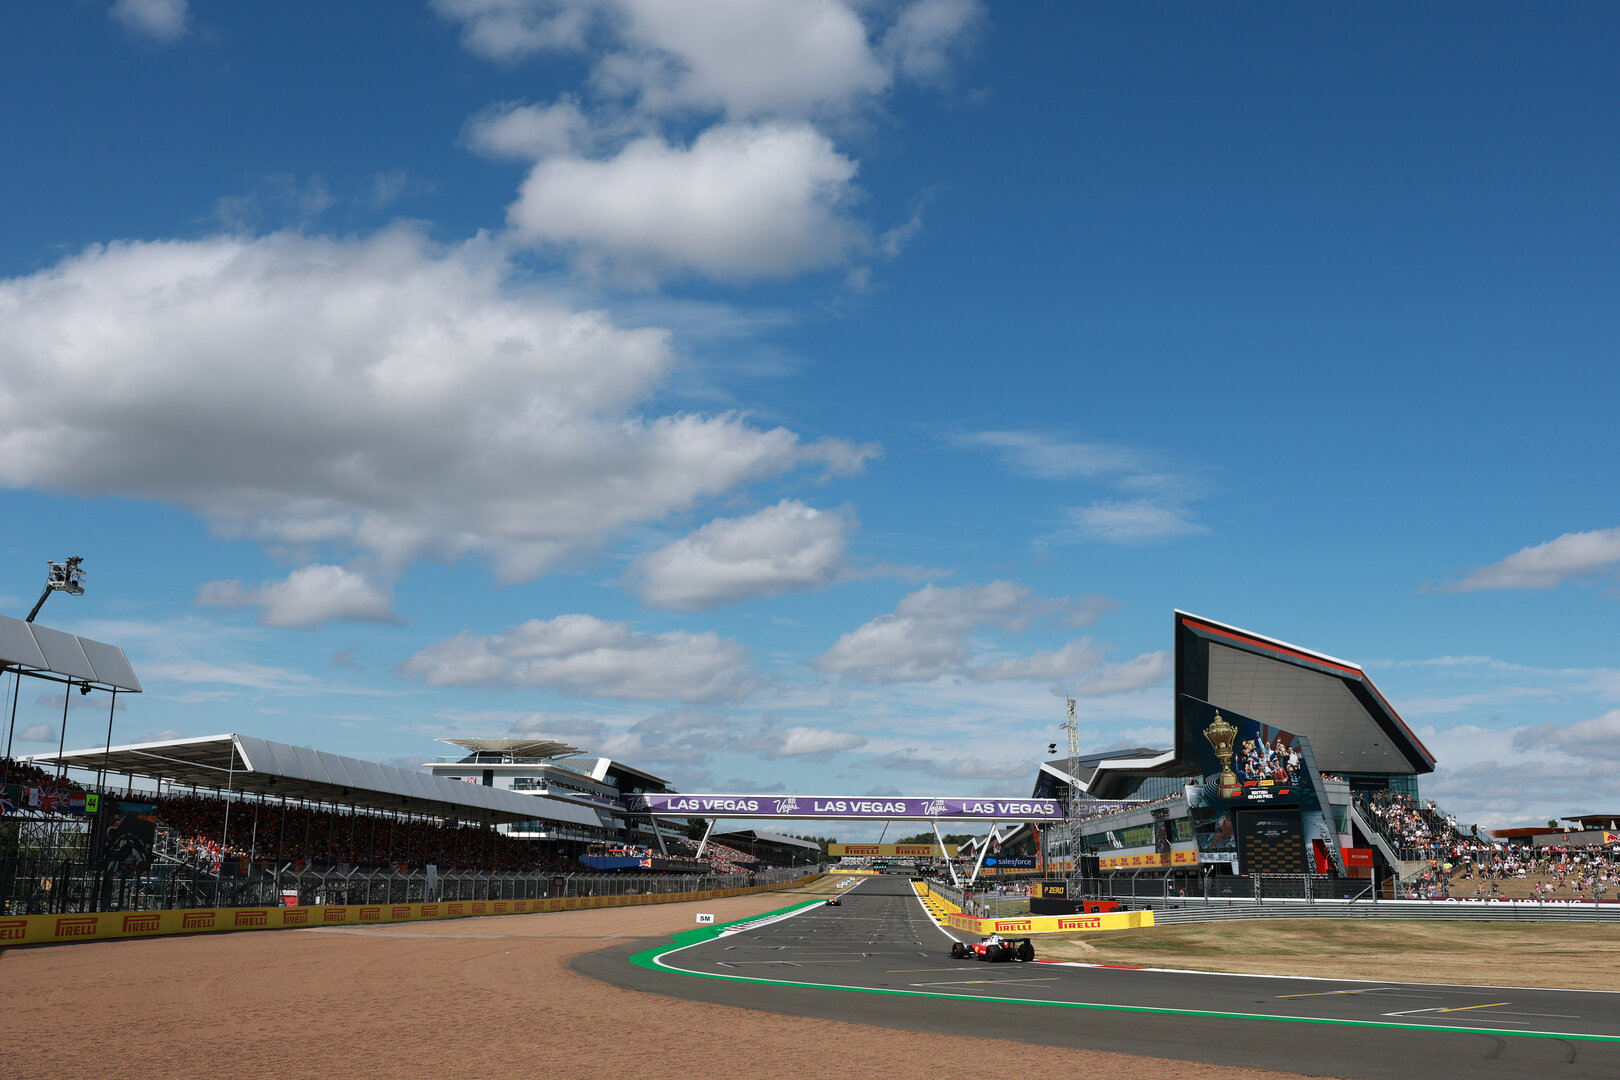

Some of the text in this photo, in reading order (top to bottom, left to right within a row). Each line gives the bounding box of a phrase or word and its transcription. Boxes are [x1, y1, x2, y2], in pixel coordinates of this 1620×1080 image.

[87, 798, 96, 808] 44
[667, 799, 758, 811] LAS VEGAS
[814, 801, 906, 813] LAS VEGAS
[962, 802, 1054, 814] LAS VEGAS
[845, 846, 879, 854] PIRELLI
[896, 846, 930, 854] PIRELLI
[998, 858, 1031, 866] salesforce
[182, 912, 216, 928] PIRELLI
[234, 911, 267, 926] PIRELLI
[283, 909, 308, 924] PIRELLI
[324, 908, 346, 921] PIRELLI
[360, 908, 380, 920] PIRELLI
[55, 917, 98, 936] PIRELLI
[122, 914, 161, 932] PIRELLI
[995, 920, 1031, 932] PIRELLI
[1058, 917, 1100, 929] PIRELLI
[0, 920, 27, 939] ELLI
